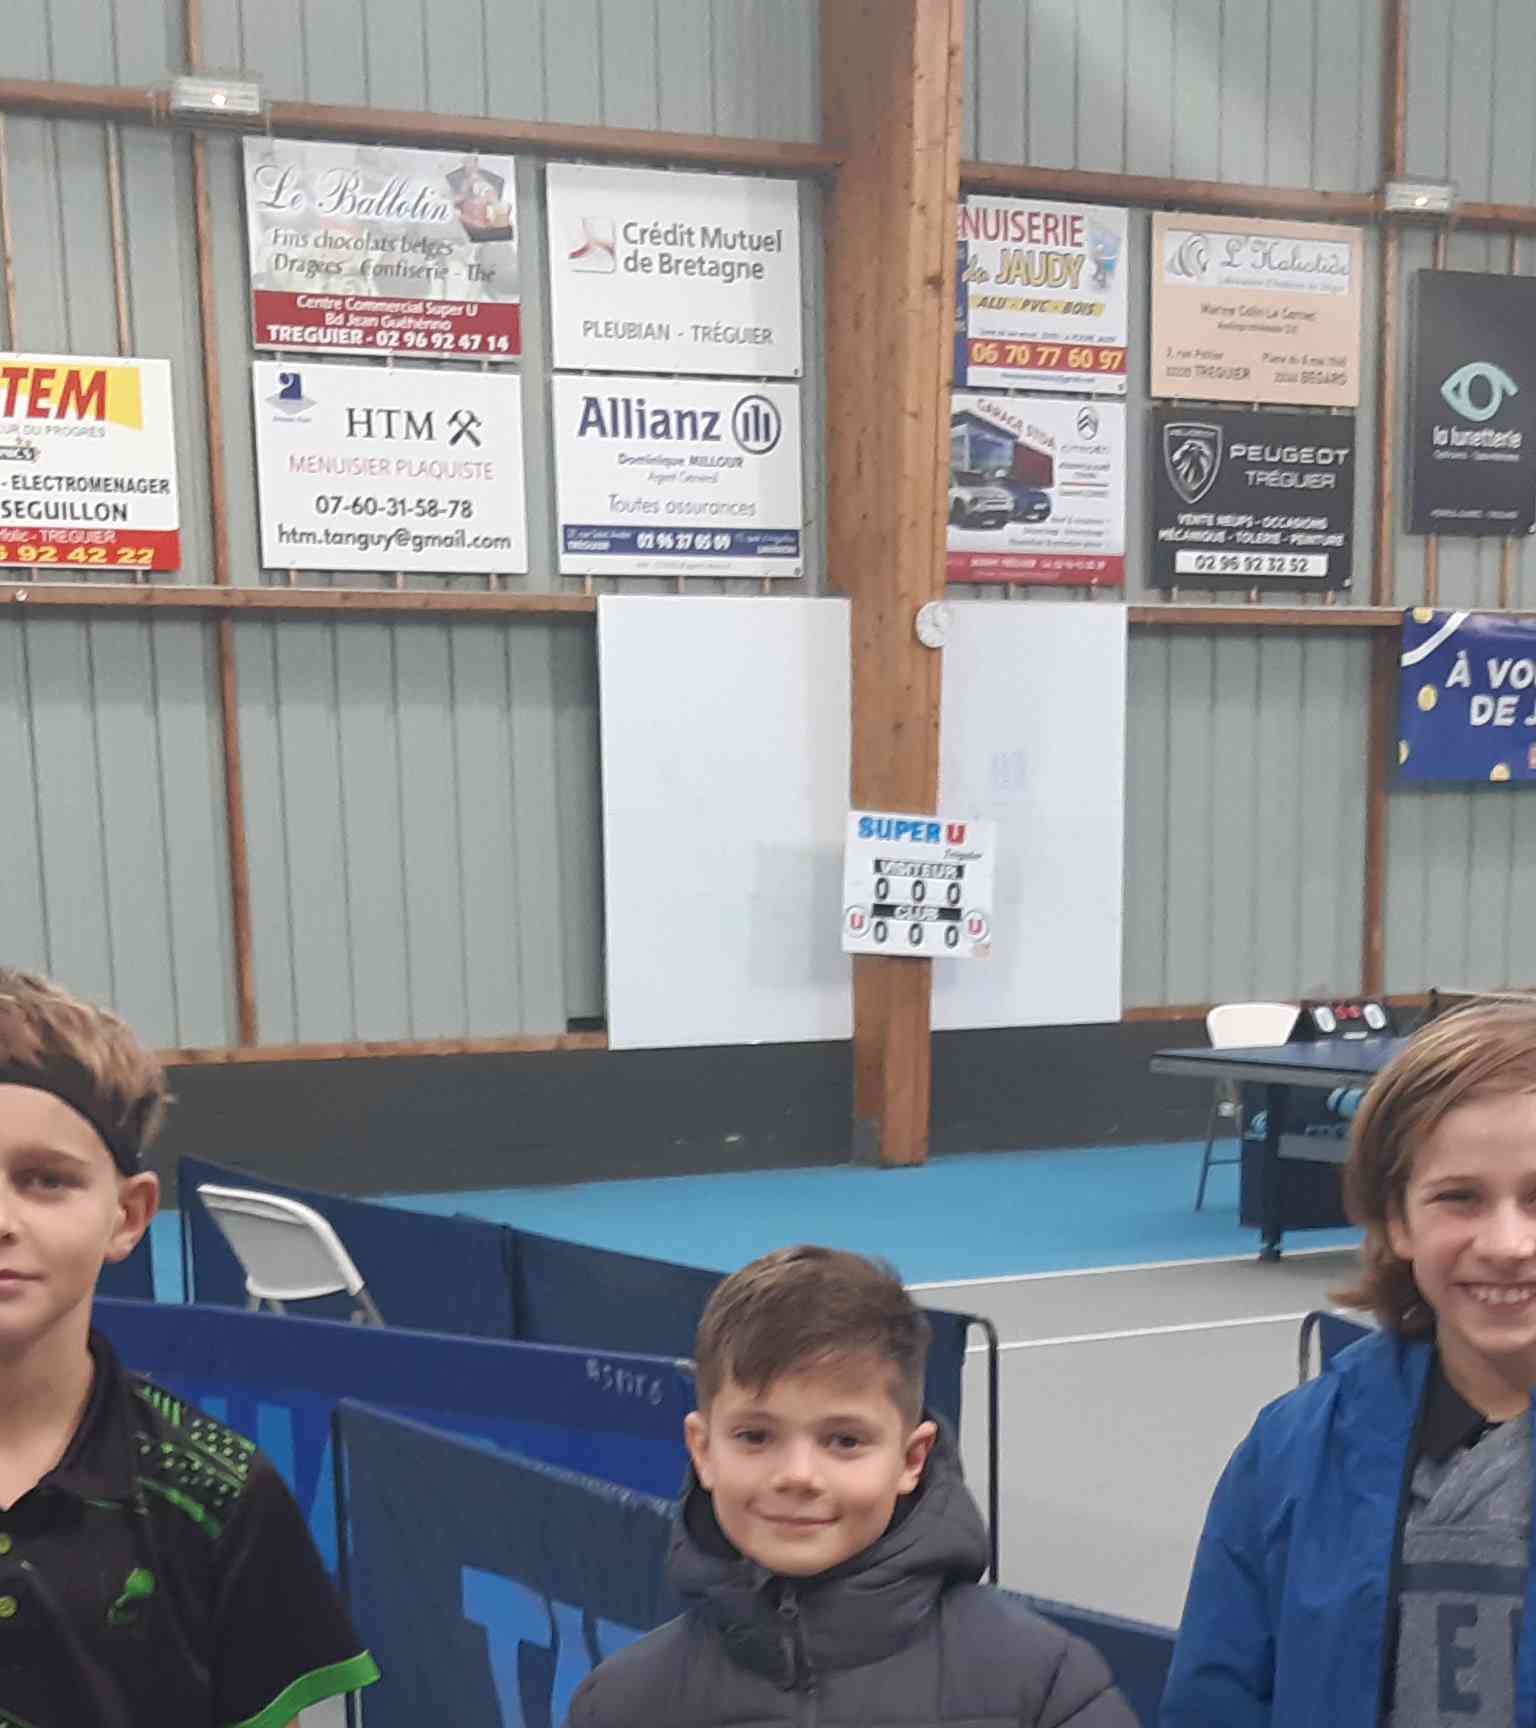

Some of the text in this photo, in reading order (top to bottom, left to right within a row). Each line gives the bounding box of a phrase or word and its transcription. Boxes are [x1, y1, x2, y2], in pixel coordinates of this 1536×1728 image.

[254, 163, 450, 222] Le Ballotin
[272, 228, 454, 259] Fins chocolats belges
[623, 221, 783, 253] Crédit Mutuel
[360, 258, 449, 281] Confiserie
[623, 249, 764, 283] de Bretagne
[996, 248, 1086, 289] JAUDY
[296, 295, 479, 318] Centre Commercial Super U
[325, 313, 344, 326] Bd
[266, 324, 509, 351] TREGUIER 02 96 92 47 14
[582, 320, 670, 341] PLEUBIAN
[972, 342, 999, 363] 06
[1005, 345, 1030, 365] 70
[1037, 346, 1063, 366] 77
[345, 408, 437, 441] HTM
[577, 396, 722, 441] Allianz
[1230, 444, 1349, 465] PEUGEOT
[289, 455, 495, 481] MENUISIER PLAQUISTE
[1245, 469, 1335, 488] TRÉGUIER
[12, 475, 170, 495] ELECTROMENAGER
[1, 500, 128, 522] SEGUILLON
[315, 495, 473, 519] 07-60-31-58-78
[608, 494, 756, 516] Toutes assurances
[40, 529, 118, 545] TREGUIER
[278, 523, 512, 552] htm.tanguy@gmail.com
[17, 545, 60, 563] 92
[67, 546, 107, 564] 42
[116, 547, 155, 565] 22
[1195, 554, 1215, 569] 02
[1445, 649, 1472, 688] À
[1470, 695, 1520, 727] DE
[858, 816, 966, 844] SUPER U
[875, 877, 961, 906] 0 0 0
[874, 921, 959, 948] 0 0 0
